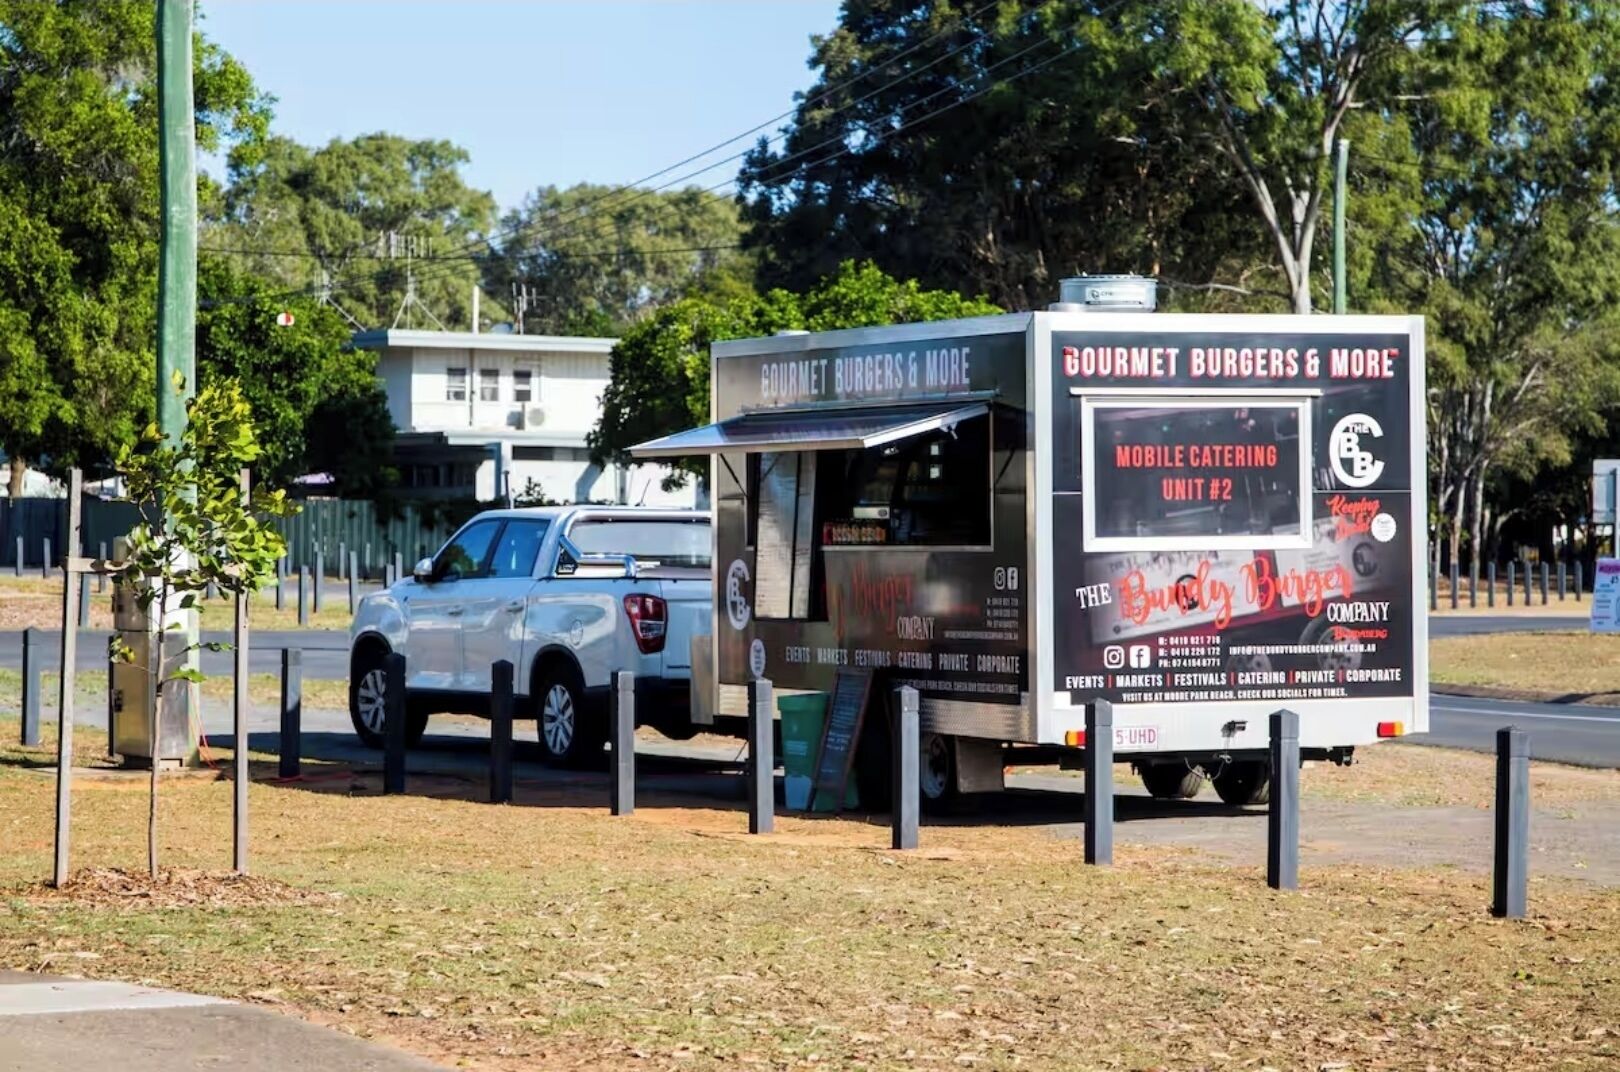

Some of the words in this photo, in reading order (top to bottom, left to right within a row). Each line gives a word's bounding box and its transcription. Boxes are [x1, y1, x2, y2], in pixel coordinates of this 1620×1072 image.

[761, 359, 829, 398] GOURMET
[835, 352, 903, 394] BURGERS
[908, 352, 918, 387] &
[925, 347, 971, 387] MORE
[1064, 347, 1179, 378] GOURMET
[1189, 348, 1299, 378] BURGERS
[1304, 349, 1320, 378] &
[1329, 348, 1397, 379] MORE
[1348, 423, 1369, 434] THE
[1115, 446, 1184, 468] MOBILE
[1189, 445, 1277, 468] CATERING
[1162, 478, 1204, 501] UNIT
[1208, 478, 1232, 501] #2
[1075, 583, 1112, 609] THE
[1116, 559, 1236, 630] Bundy
[1238, 556, 1353, 617] Burger
[1326, 601, 1390, 622] COMPANY
[897, 616, 935, 640] COMPANY
[785, 646, 811, 663] EVENTS
[817, 648, 848, 665] MARKETS
[855, 649, 891, 667] FESTIVALS
[898, 651, 932, 670] CATERING
[939, 653, 968, 672] PRIVATE
[977, 654, 1020, 674] CORPORATE
[1065, 676, 1104, 689] EVENTS
[1116, 674, 1162, 688] MARKETS
[1174, 673, 1227, 686] FESTIVALS
[1238, 672, 1286, 685] CATERING
[1295, 670, 1335, 683] PRIVATE
[1346, 668, 1401, 682] CORPORATE
[1122, 692, 1142, 702] VISIT
[1154, 692, 1163, 702] AT
[1190, 691, 1209, 701] PARK
[1237, 689, 1261, 699] CHECK
[1277, 688, 1307, 698] SOCIALS
